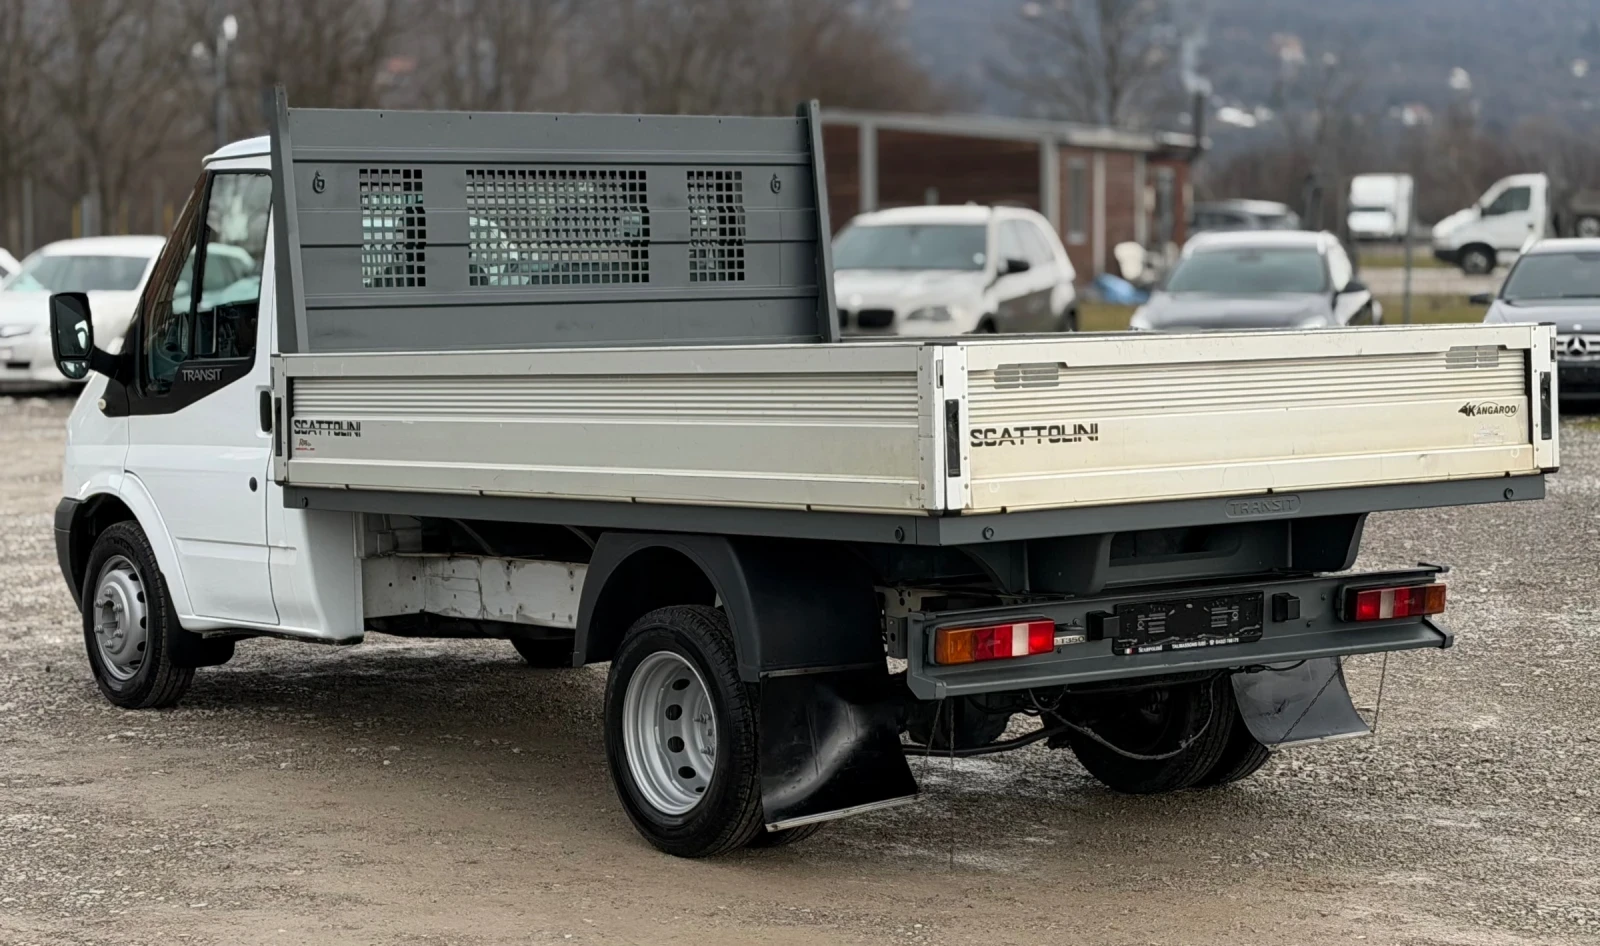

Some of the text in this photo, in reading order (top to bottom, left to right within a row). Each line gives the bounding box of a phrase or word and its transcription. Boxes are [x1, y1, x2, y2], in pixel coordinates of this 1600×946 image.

[181, 369, 222, 381] TRANSIT
[1468, 404, 1517, 417] KANGAROO
[294, 419, 362, 437] SCATTOLINI
[970, 423, 1099, 447] SCATTOLINI
[1230, 499, 1295, 515] TRANSIT
